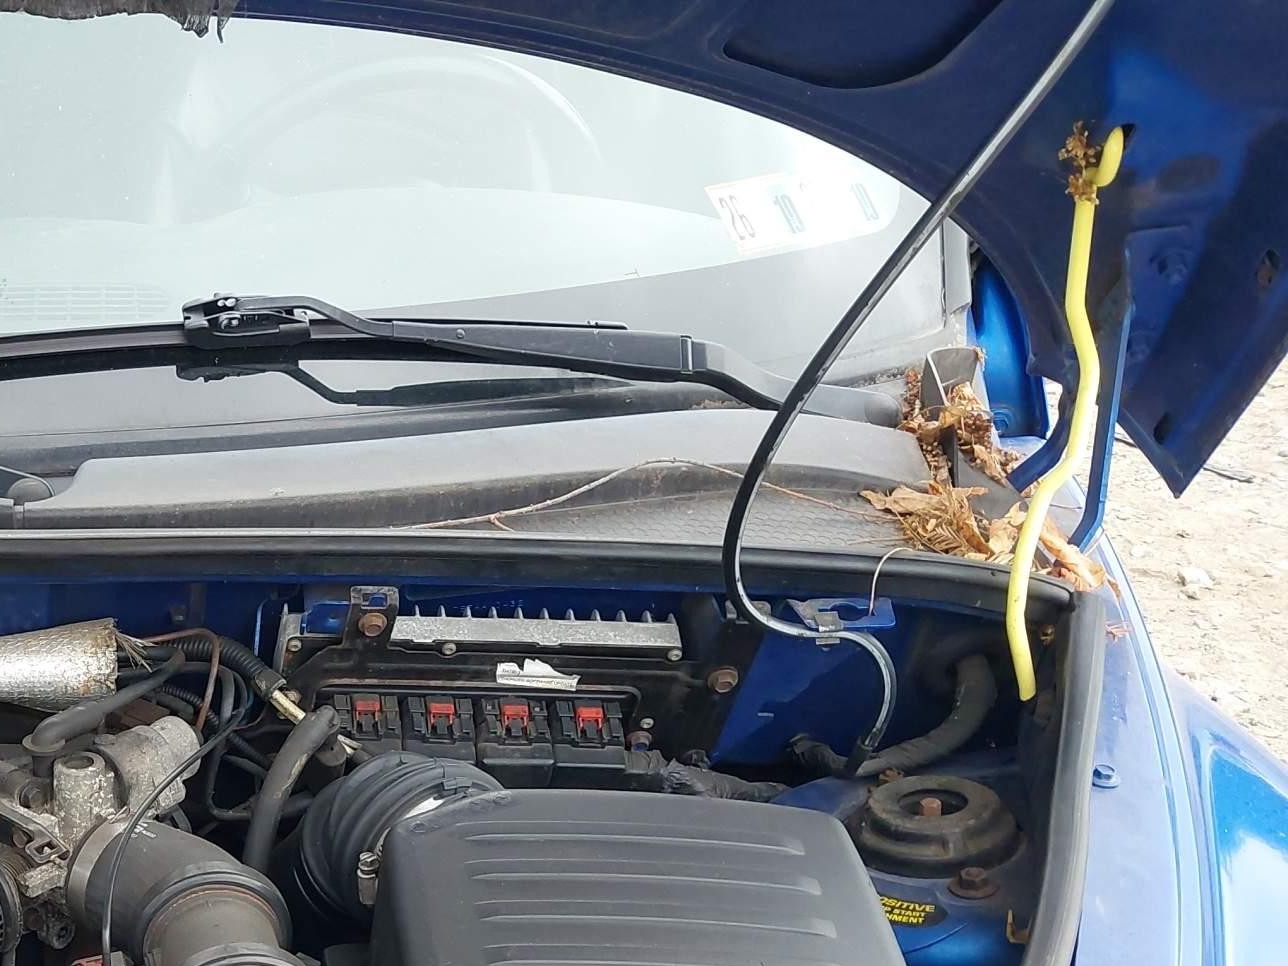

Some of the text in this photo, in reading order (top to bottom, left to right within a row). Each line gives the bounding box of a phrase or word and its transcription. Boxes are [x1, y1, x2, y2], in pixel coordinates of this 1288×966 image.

[718, 194, 756, 241] 26
[880, 896, 936, 913] OSITIVE
[892, 909, 928, 918] START
